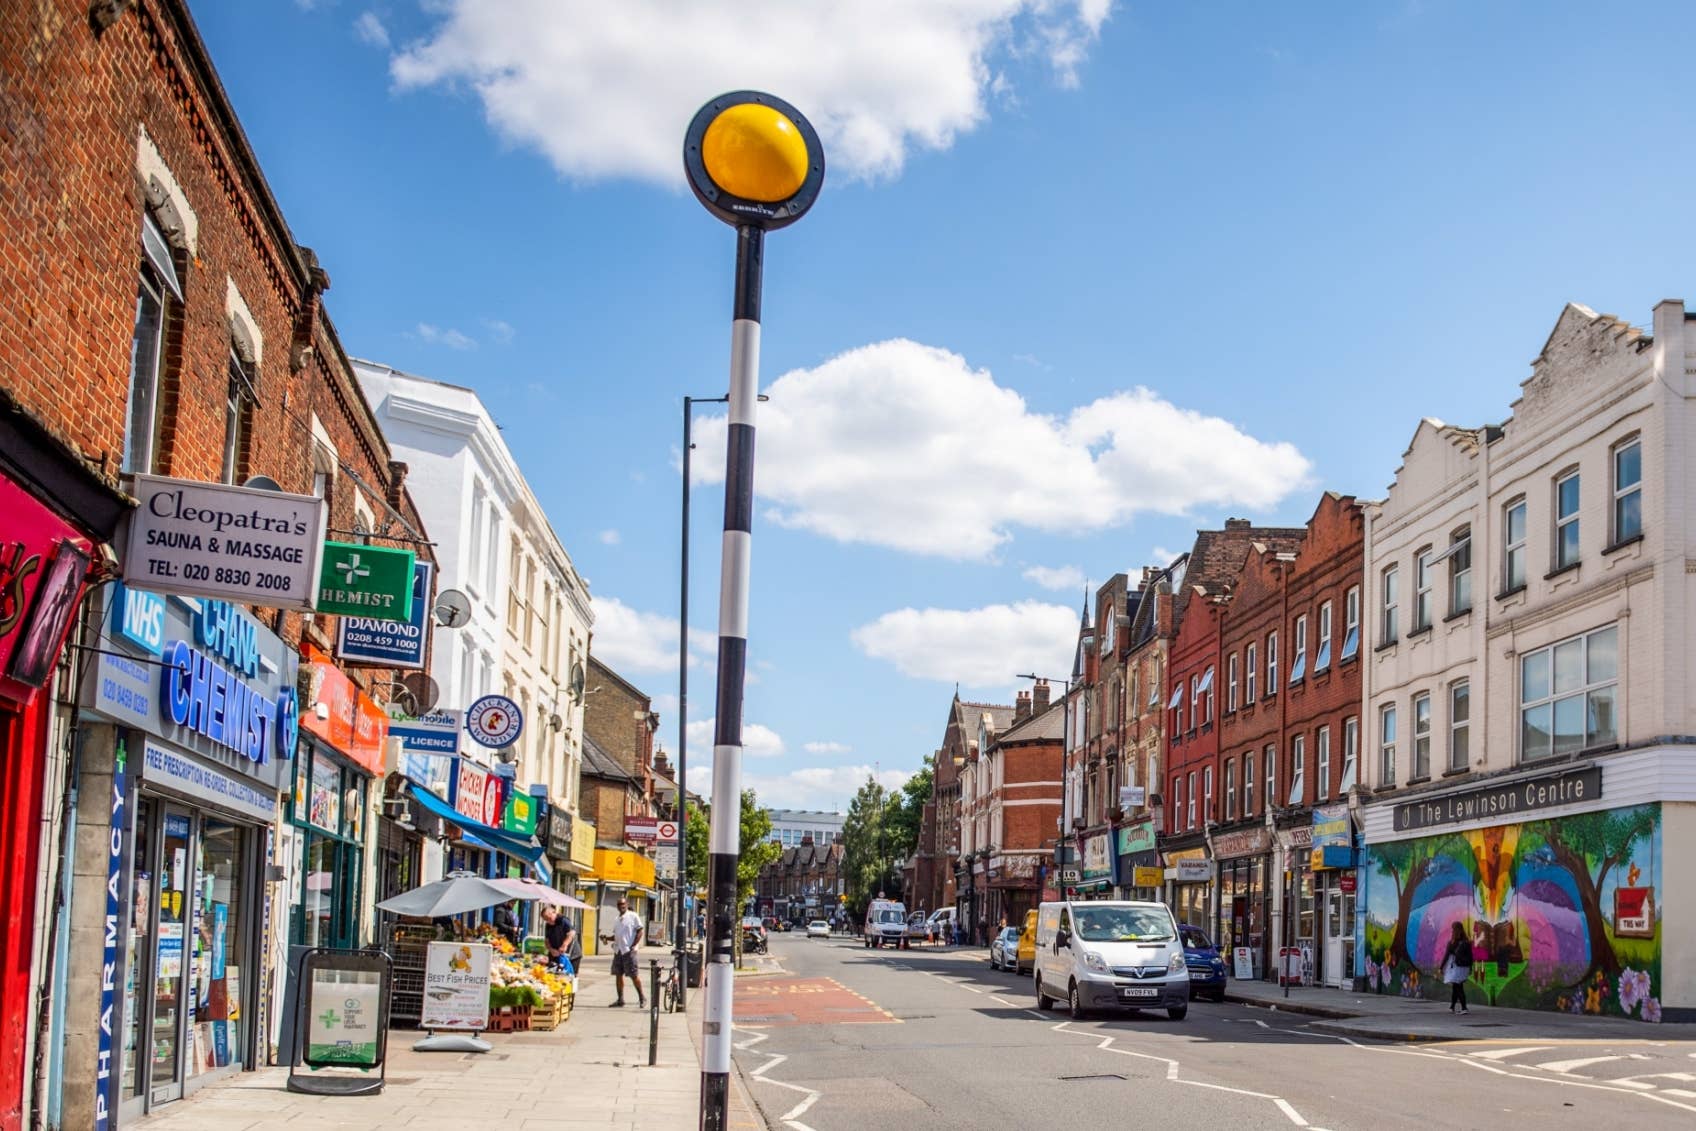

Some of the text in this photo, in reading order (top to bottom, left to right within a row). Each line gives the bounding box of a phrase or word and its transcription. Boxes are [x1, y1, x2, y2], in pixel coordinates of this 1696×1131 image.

[149, 490, 307, 536] Cleopatra's
[146, 529, 303, 564] SAUNA & MASSAGE
[148, 559, 291, 591] TEL: 020 8830 2008
[321, 588, 395, 608] HEMIST
[124, 589, 164, 648] NHS
[348, 618, 419, 638] DIAMOND
[202, 596, 259, 680] CHANA
[347, 632, 372, 643] 0208
[374, 636, 392, 646] 459
[395, 639, 418, 649] 1000
[170, 639, 276, 767] CHEMIST
[471, 698, 517, 721] CHICKEN
[411, 737, 454, 748] LICENCE
[473, 723, 518, 744] WONDER
[146, 747, 162, 771] FREE
[164, 753, 204, 785] PRESCRIPTION
[1418, 779, 1585, 825] The Lewinson Centre
[97, 784, 125, 1121] PHARMACY
[427, 972, 488, 985] BEST FISH PRICES
